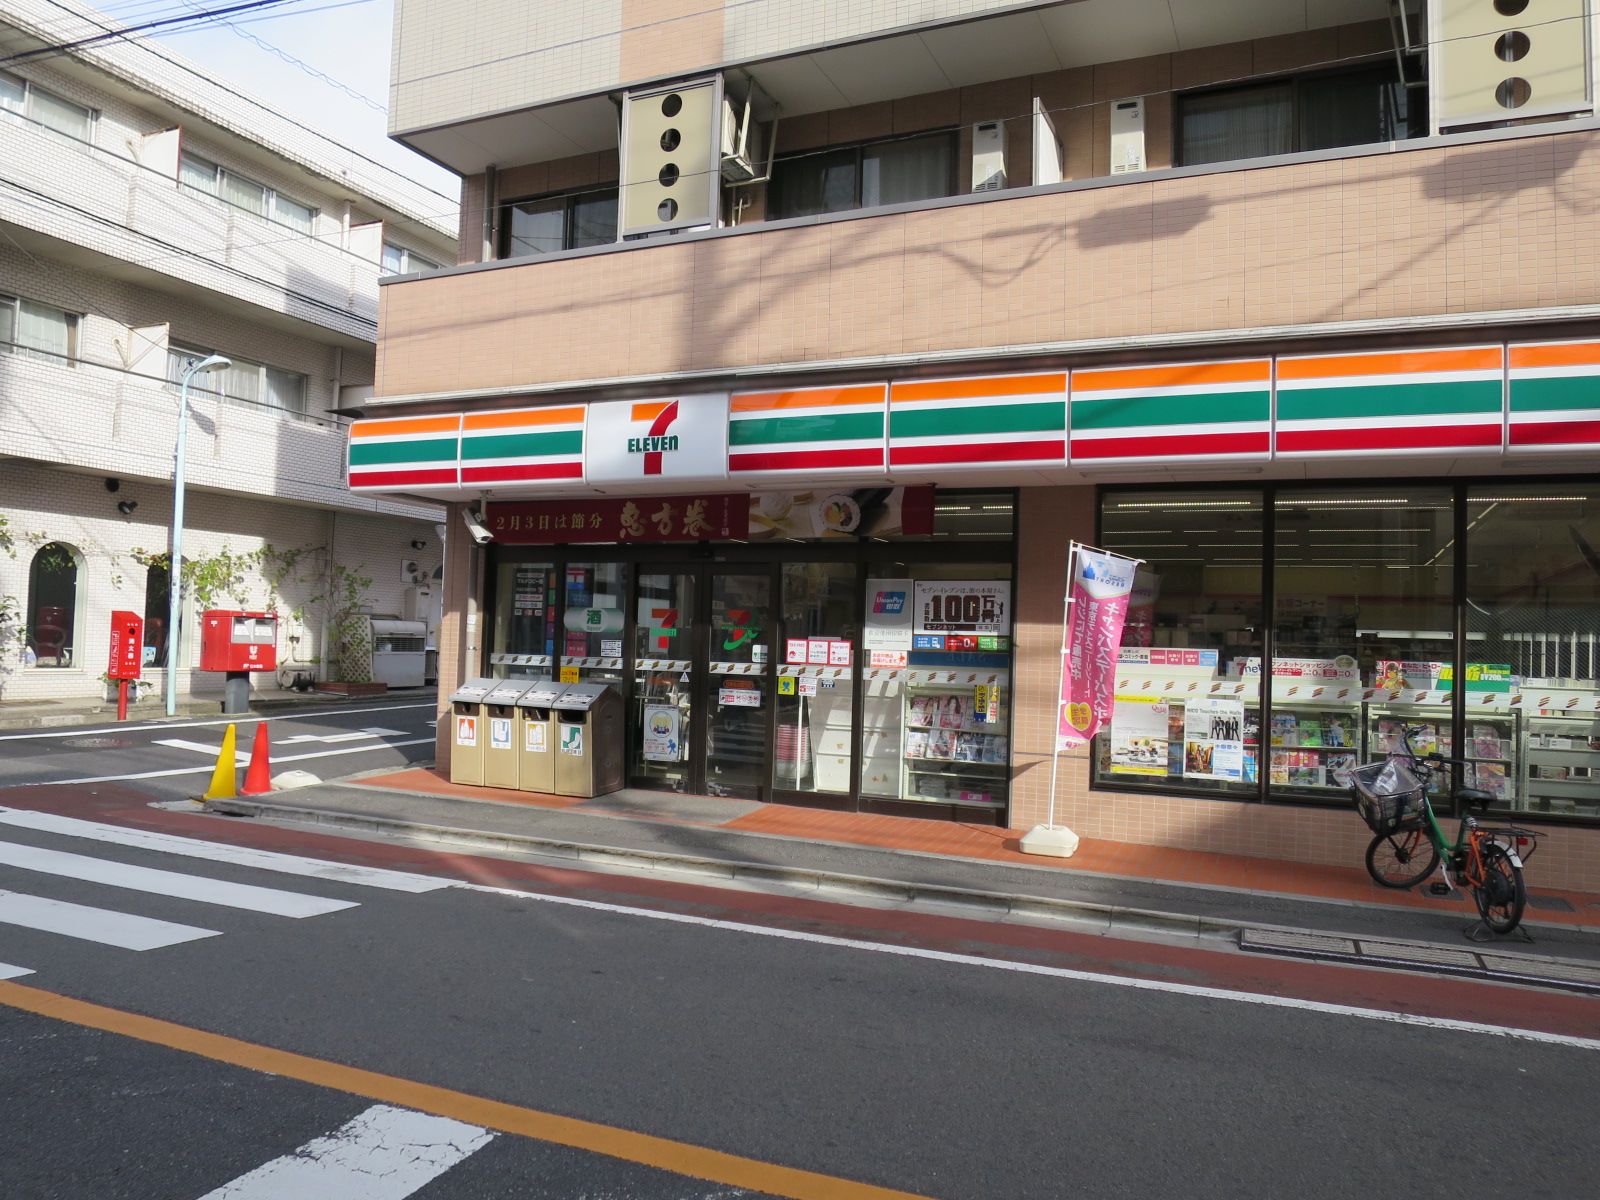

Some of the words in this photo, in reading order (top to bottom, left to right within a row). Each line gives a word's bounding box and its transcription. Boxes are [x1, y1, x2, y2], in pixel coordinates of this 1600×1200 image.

[630, 399, 679, 475] 7
[496, 512, 603, 530] 2月3日は節分
[586, 610, 602, 625] 酒
